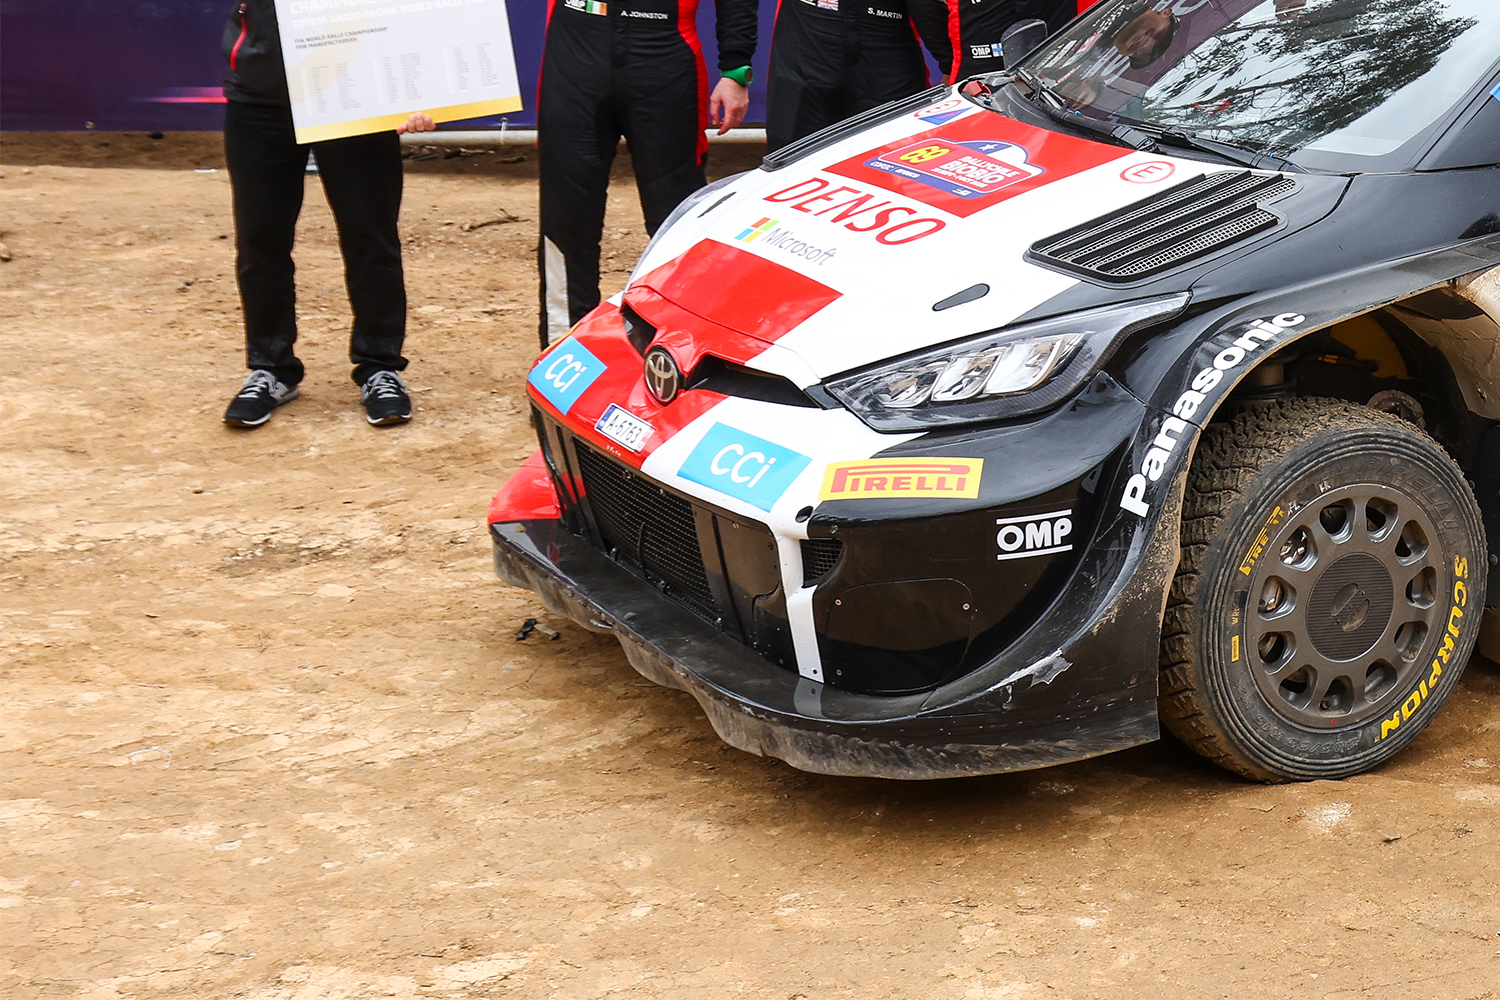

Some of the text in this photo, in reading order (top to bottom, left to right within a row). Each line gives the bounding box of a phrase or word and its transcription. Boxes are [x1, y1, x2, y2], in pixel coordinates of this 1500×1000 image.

[629, 11, 668, 19] JOHNSTON
[877, 9, 903, 19] MARTIN
[900, 145, 951, 164] 69
[762, 177, 946, 246] DENSO
[762, 226, 837, 266] Microsoft
[544, 353, 588, 393] CCi
[606, 413, 643, 444] A-6763
[1119, 312, 1305, 518] Panasonic
[711, 443, 777, 488] CCi
[831, 463, 970, 494] PIRELLI
[998, 518, 1071, 550] OMP
